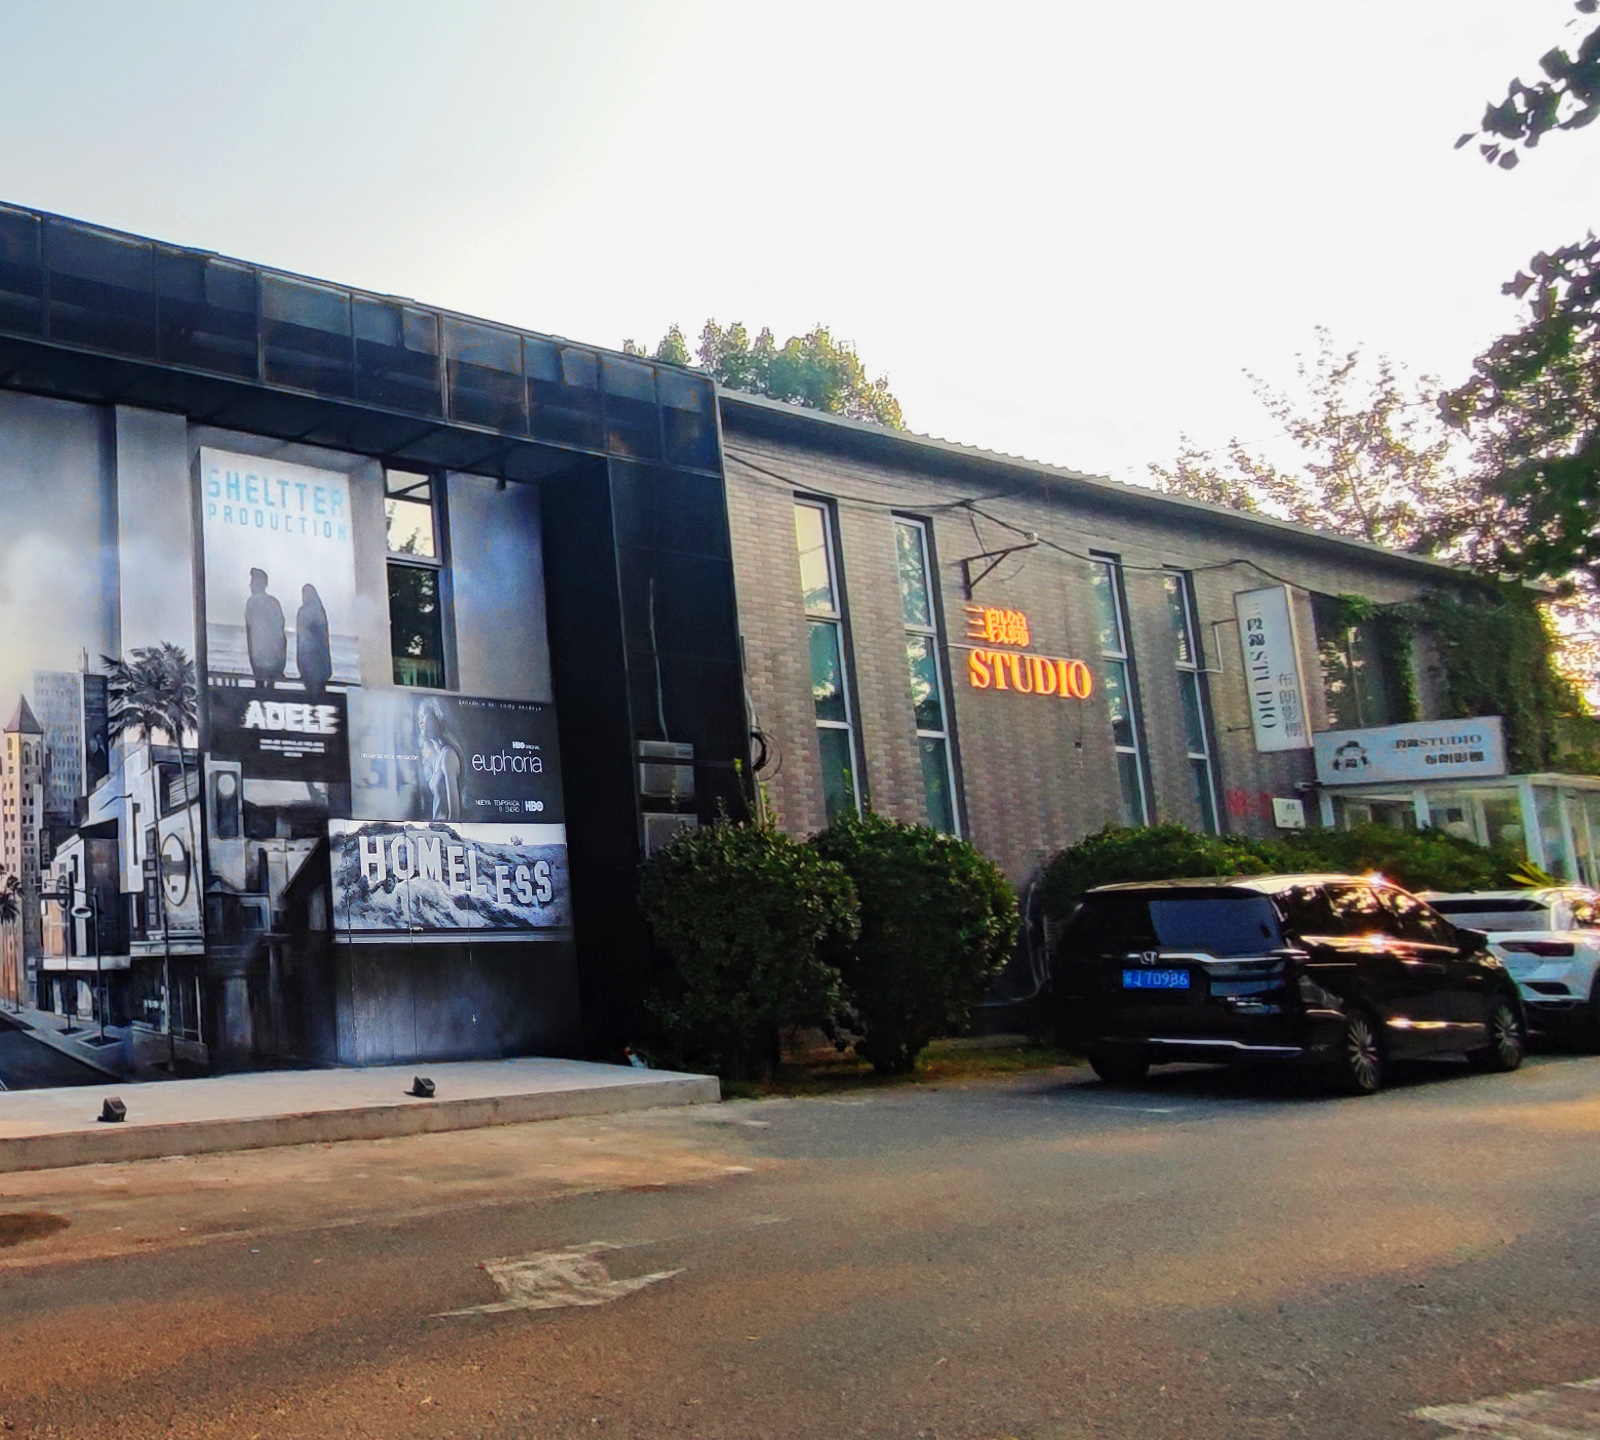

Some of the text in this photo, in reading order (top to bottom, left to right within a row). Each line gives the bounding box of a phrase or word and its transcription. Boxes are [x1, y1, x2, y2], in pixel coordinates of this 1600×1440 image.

[207, 468, 343, 517] SHELTTER
[208, 502, 346, 541] PRODUCTION
[969, 648, 1093, 699] STUDIO
[242, 700, 340, 735] ADELE
[471, 749, 543, 776] euphoria
[512, 741, 526, 749] HBO
[525, 800, 544, 812] HBO
[358, 836, 552, 904] HOMELESS
